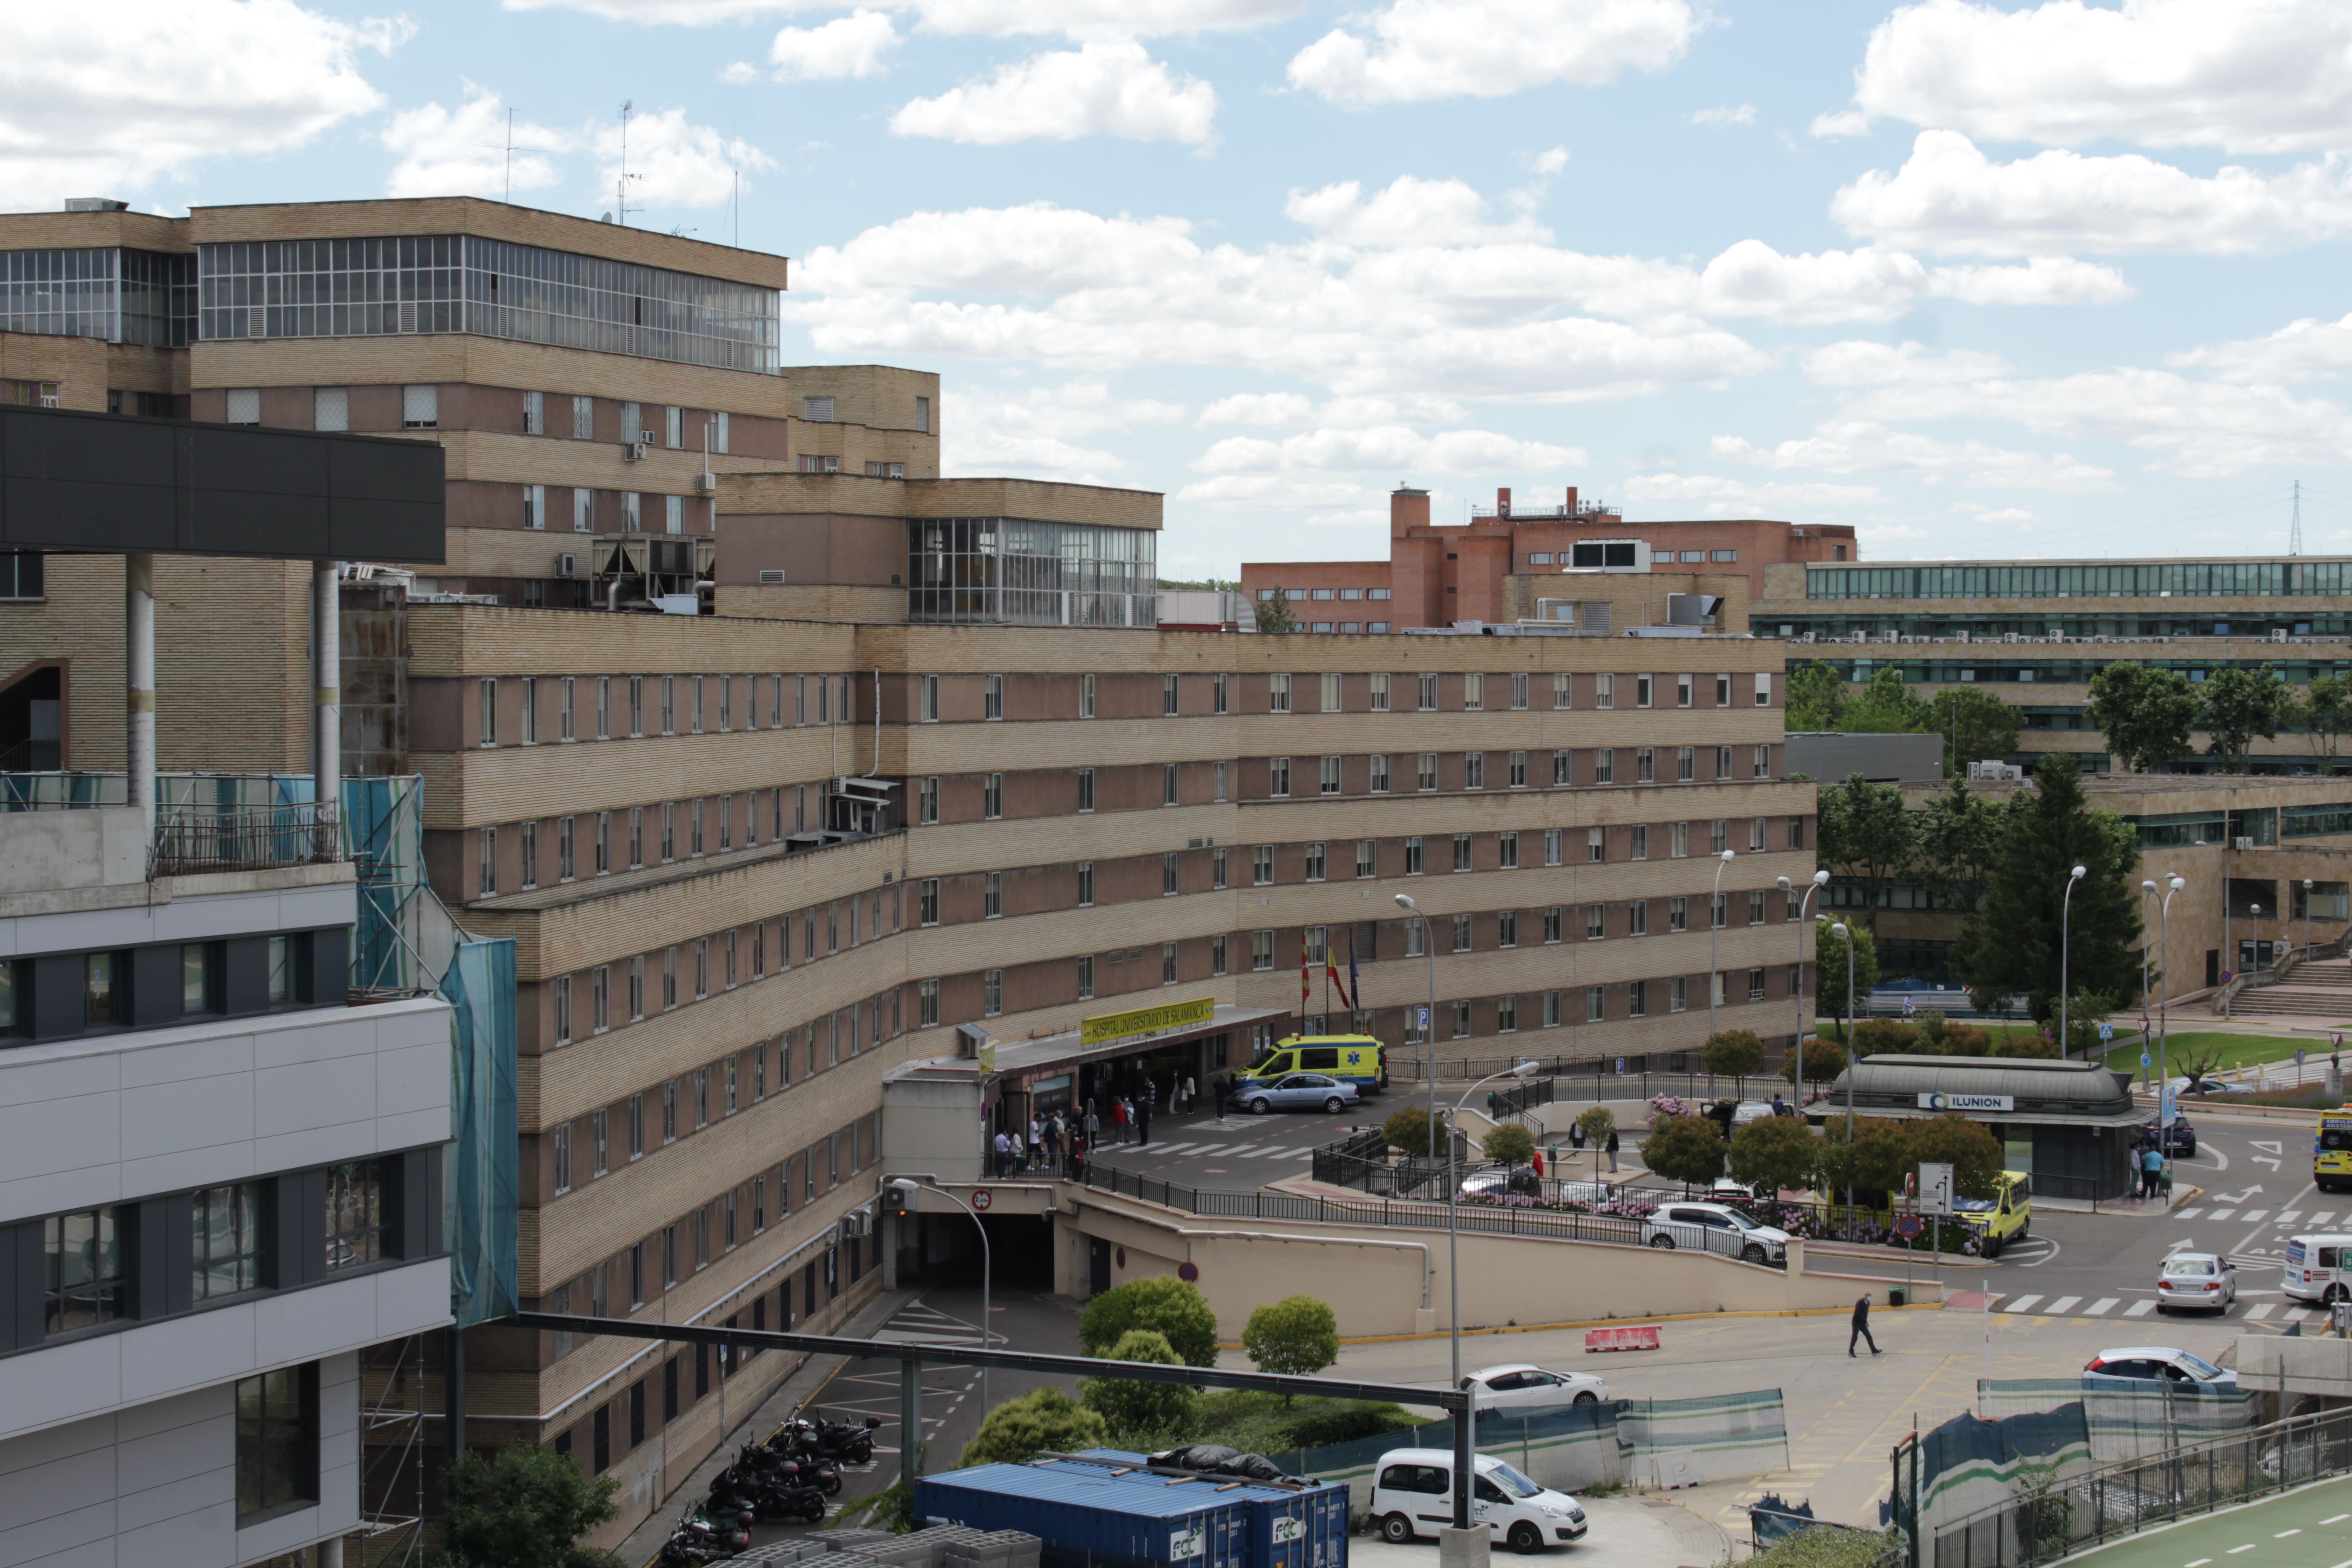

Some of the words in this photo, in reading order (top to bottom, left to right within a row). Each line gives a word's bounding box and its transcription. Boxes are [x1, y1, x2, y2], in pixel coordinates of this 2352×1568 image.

[1092, 1021, 1119, 1039] HOSPITAL
[1120, 1011, 1161, 1033] UNIVERSITARIO
[1162, 1010, 1170, 1024] DE
[1171, 1004, 1204, 1021] SALAMANCA
[1420, 1010, 1426, 1024] P
[1952, 1097, 2001, 1107] ILUNION
[1275, 1520, 1297, 1541] FCC
[1173, 1537, 1196, 1558] FCC
